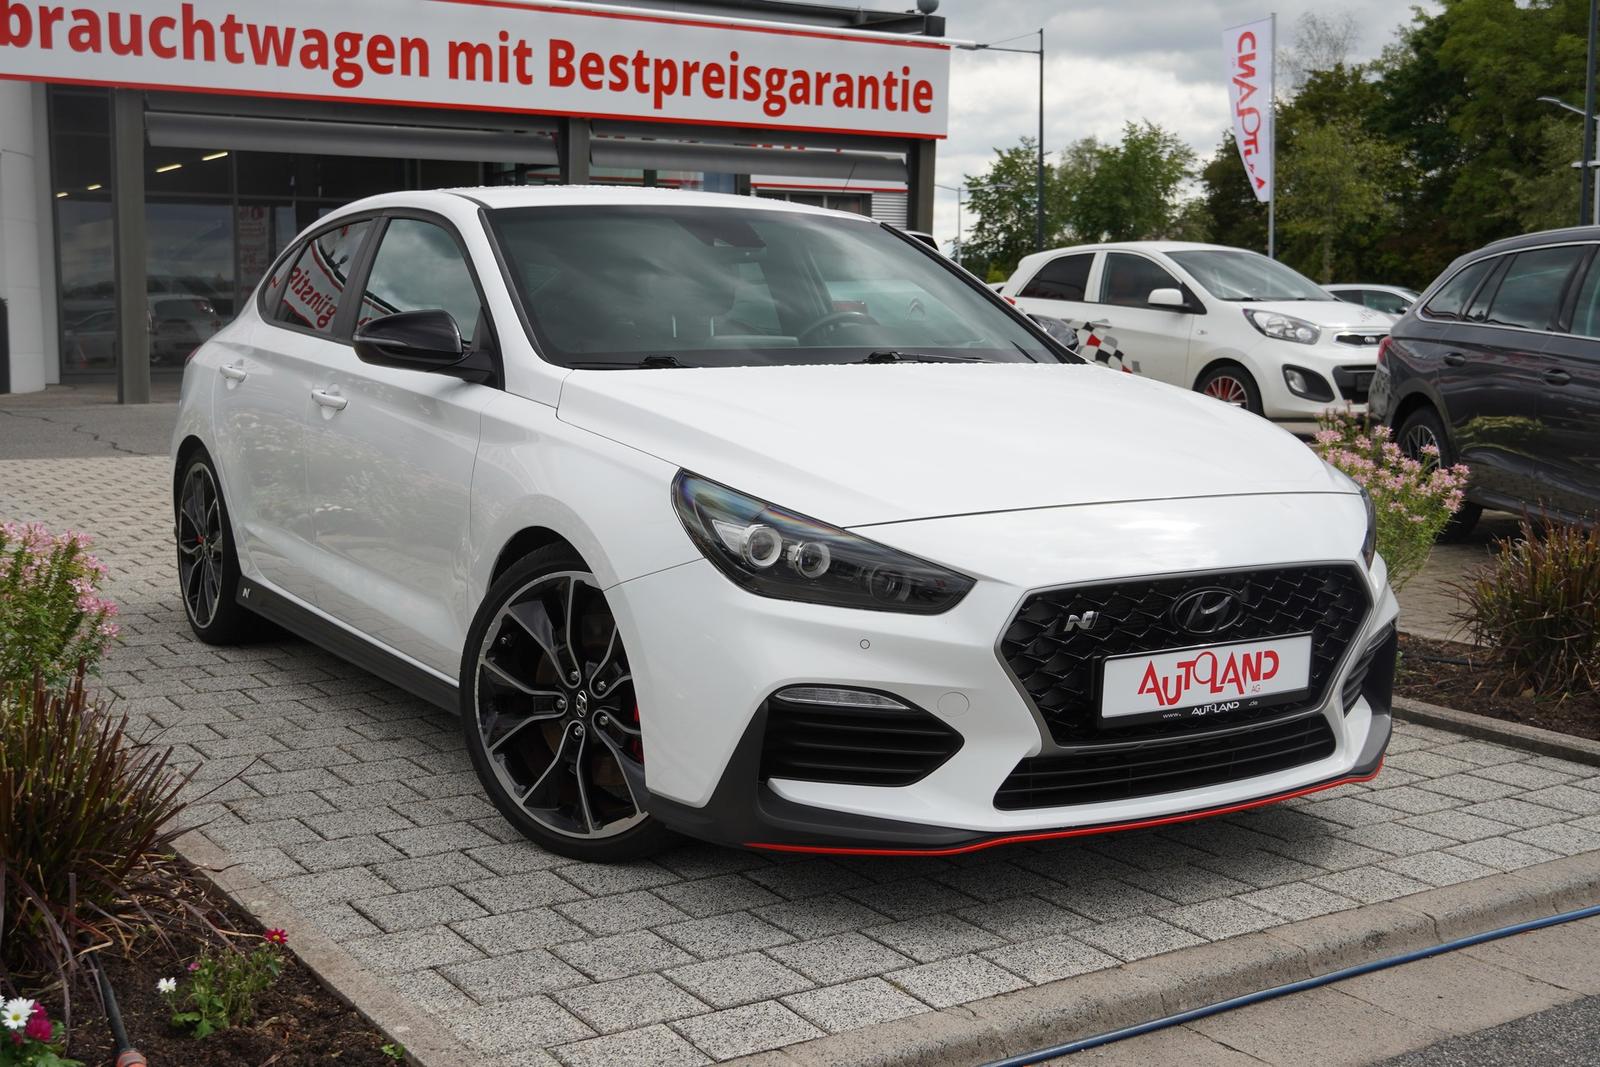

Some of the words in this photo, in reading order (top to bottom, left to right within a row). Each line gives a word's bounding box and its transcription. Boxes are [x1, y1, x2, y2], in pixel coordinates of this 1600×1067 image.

[0, 0, 430, 88] brauchtwagen
[448, 30, 534, 86] mit
[549, 38, 934, 118] Bestpreisgarantie
[242, 587, 251, 599] N
[1063, 610, 1099, 632] N
[1251, 684, 1261, 692] AG
